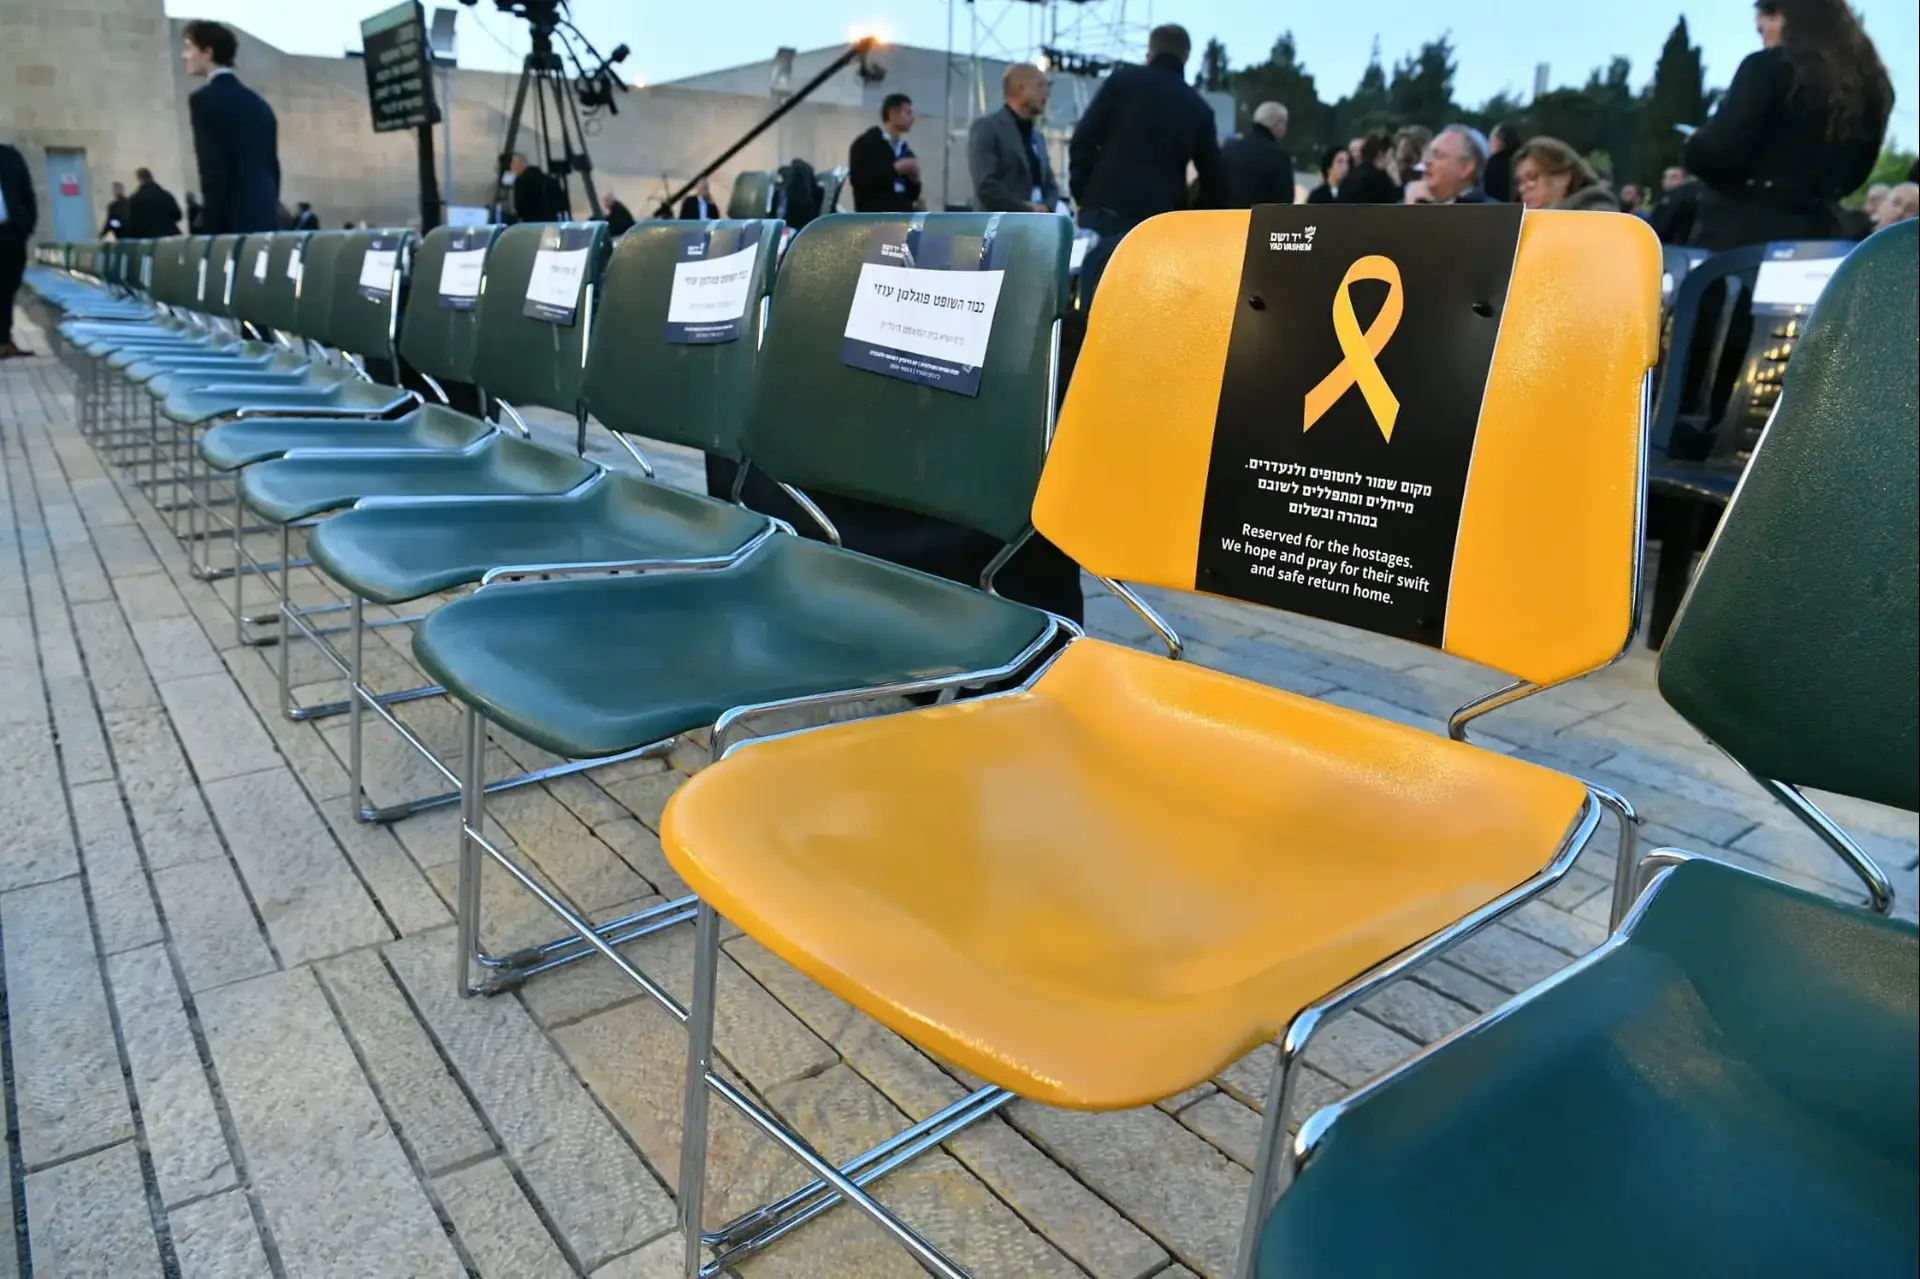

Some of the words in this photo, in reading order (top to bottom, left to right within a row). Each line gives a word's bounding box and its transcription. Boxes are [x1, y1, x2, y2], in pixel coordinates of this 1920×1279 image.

[1270, 232, 1290, 242] ושם
[1291, 232, 1302, 242] יד
[1270, 242, 1282, 250] YAD
[1284, 243, 1312, 251] VASHEM
[874, 283, 894, 298] עוזי
[897, 288, 931, 305] פוגלמן
[934, 295, 964, 311] השופט
[968, 300, 985, 314] כבוד
[1245, 458, 1306, 477] ולנעדרים.
[1310, 467, 1362, 486] לחטופים
[1366, 476, 1397, 492] שמור
[1258, 478, 1299, 495] לשובם
[1401, 481, 1432, 498] מקום
[1302, 486, 1362, 506] ומתפללים
[1288, 502, 1334, 521] ובשלום
[1366, 496, 1414, 514] מייחלים
[1337, 510, 1378, 528] במהרה
[1242, 523, 1302, 546] Reserved
[1305, 534, 1324, 550] for
[1328, 539, 1349, 554] the
[1352, 544, 1413, 569] hostages.
[1222, 538, 1241, 552] We
[1244, 542, 1276, 561] hope
[1280, 548, 1304, 565] and
[1307, 556, 1337, 575] pray
[1340, 561, 1359, 576] for
[1362, 566, 1394, 584] their
[1397, 575, 1430, 592] swift
[1250, 562, 1275, 579] and
[1278, 568, 1304, 584] safe
[1308, 575, 1349, 594] return
[1353, 584, 1394, 604] home.
